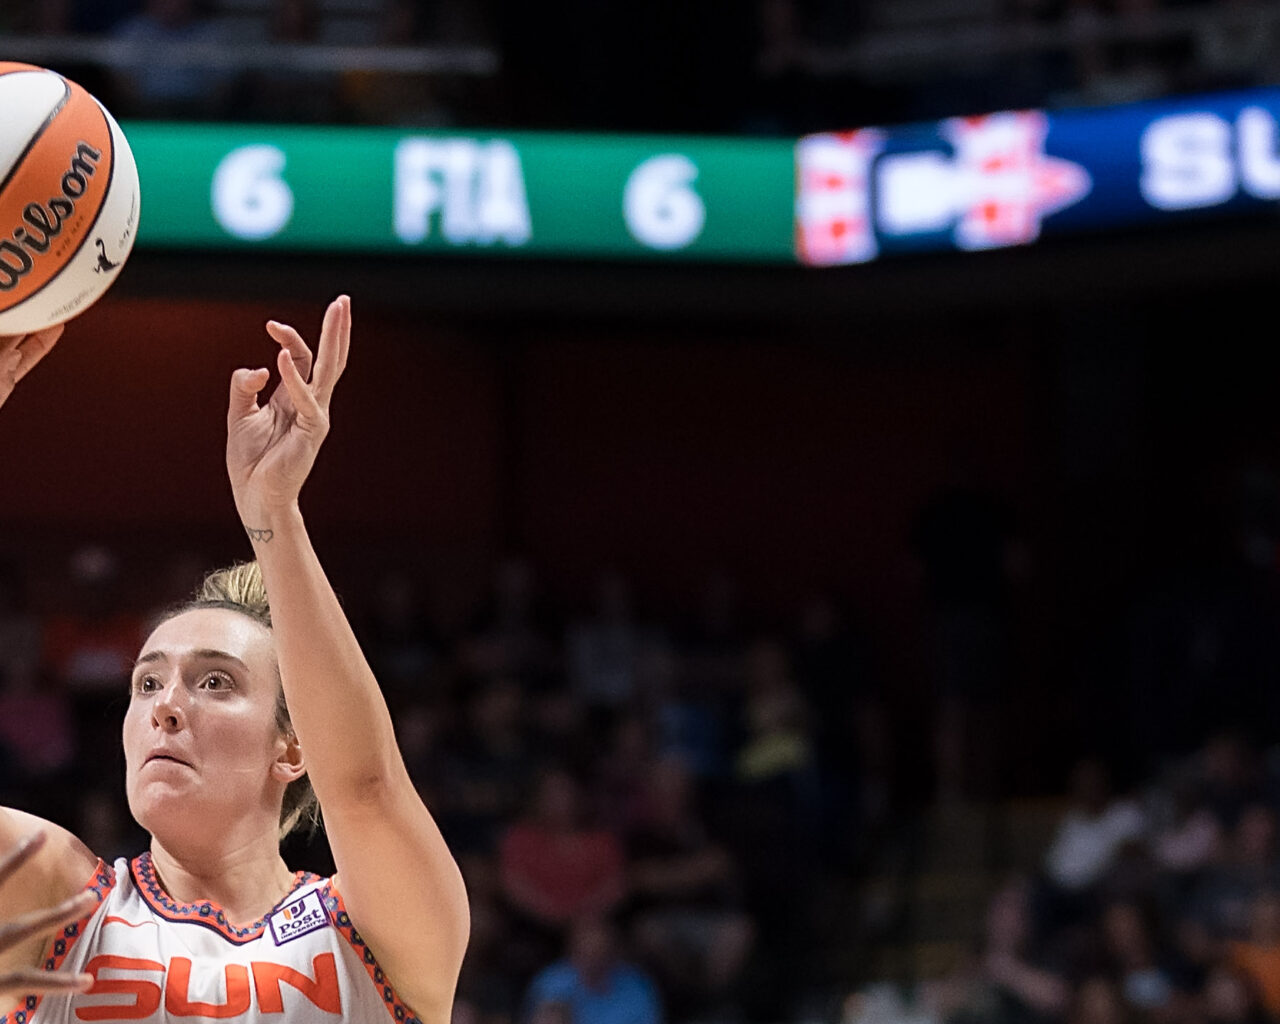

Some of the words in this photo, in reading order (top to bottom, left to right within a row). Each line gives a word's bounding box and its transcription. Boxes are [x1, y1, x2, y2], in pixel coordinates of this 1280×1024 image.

[210, 143, 295, 241] 6
[392, 136, 533, 245] FTA
[623, 153, 706, 250] 6
[75, 952, 342, 1021] SUN
